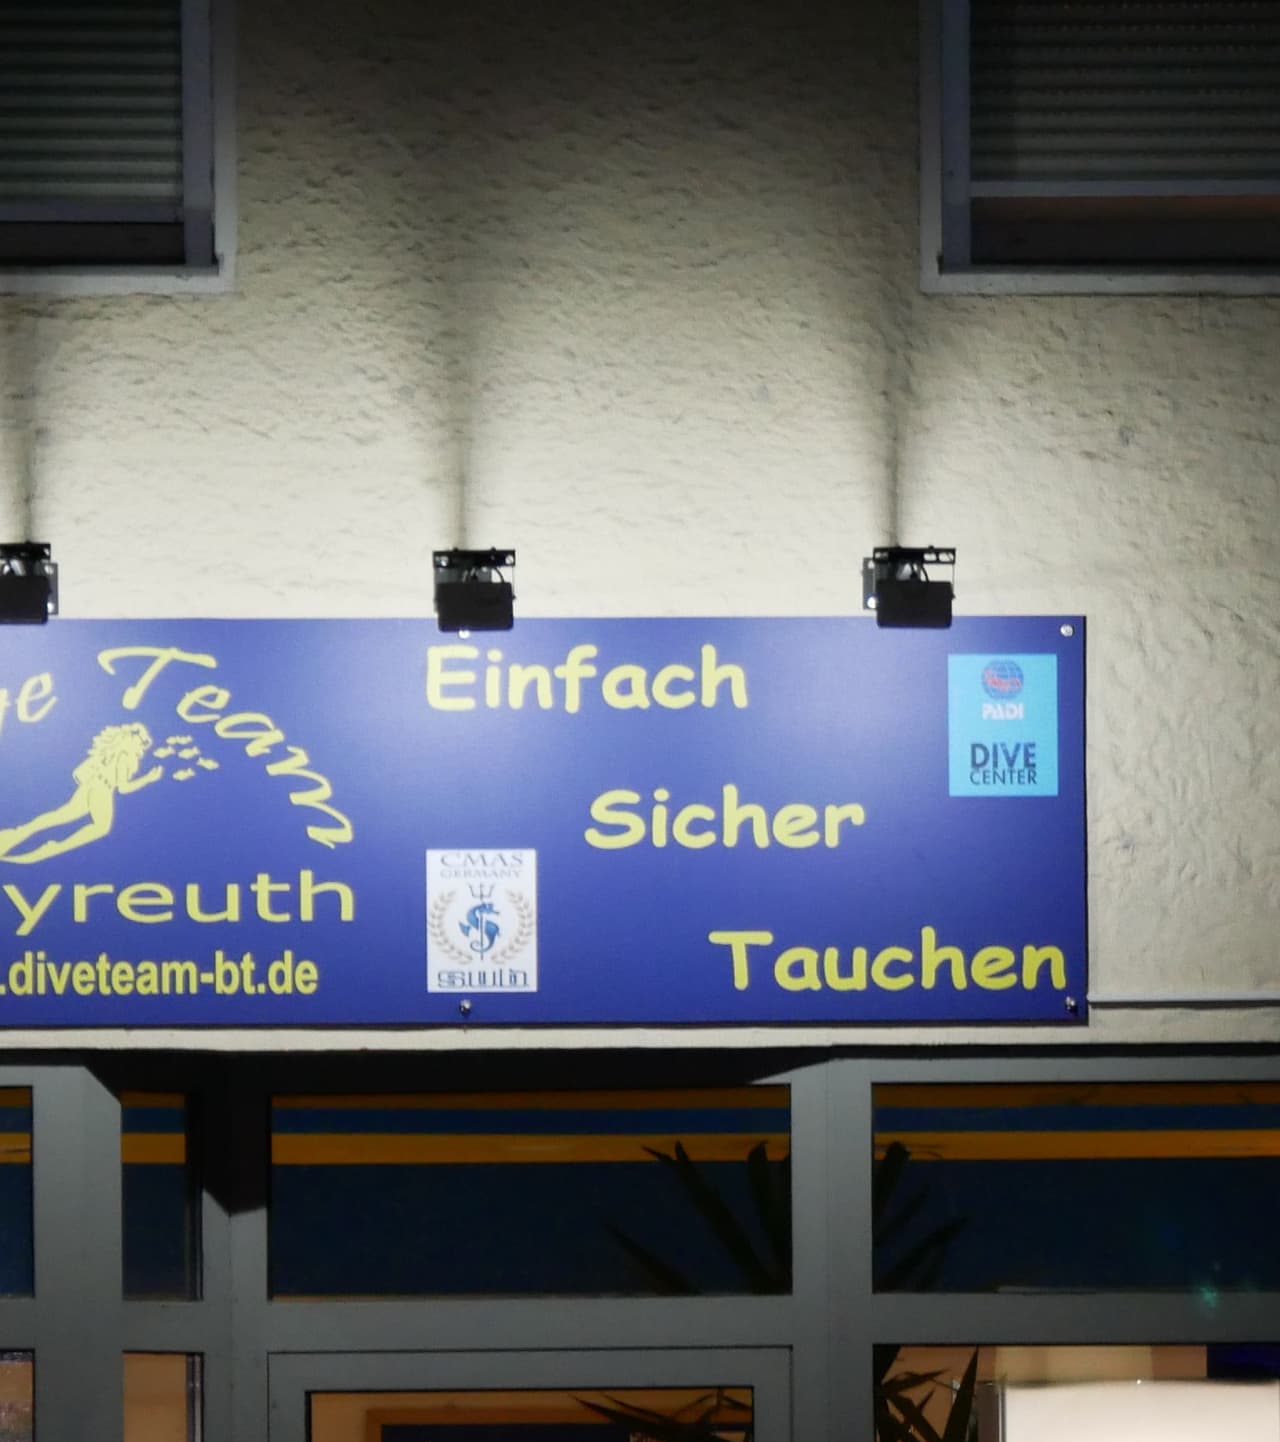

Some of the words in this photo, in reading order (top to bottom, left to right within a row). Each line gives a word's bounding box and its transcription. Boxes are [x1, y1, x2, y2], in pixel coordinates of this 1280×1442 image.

[425, 643, 749, 714] Einfach
[982, 702, 1024, 720] PADI
[97, 646, 354, 849] Team
[970, 742, 1036, 769] DIVE
[970, 768, 1037, 785] CENTER
[584, 783, 866, 850] Sicher
[440, 853, 523, 867] CMAS
[707, 926, 1067, 991] Tauchen
